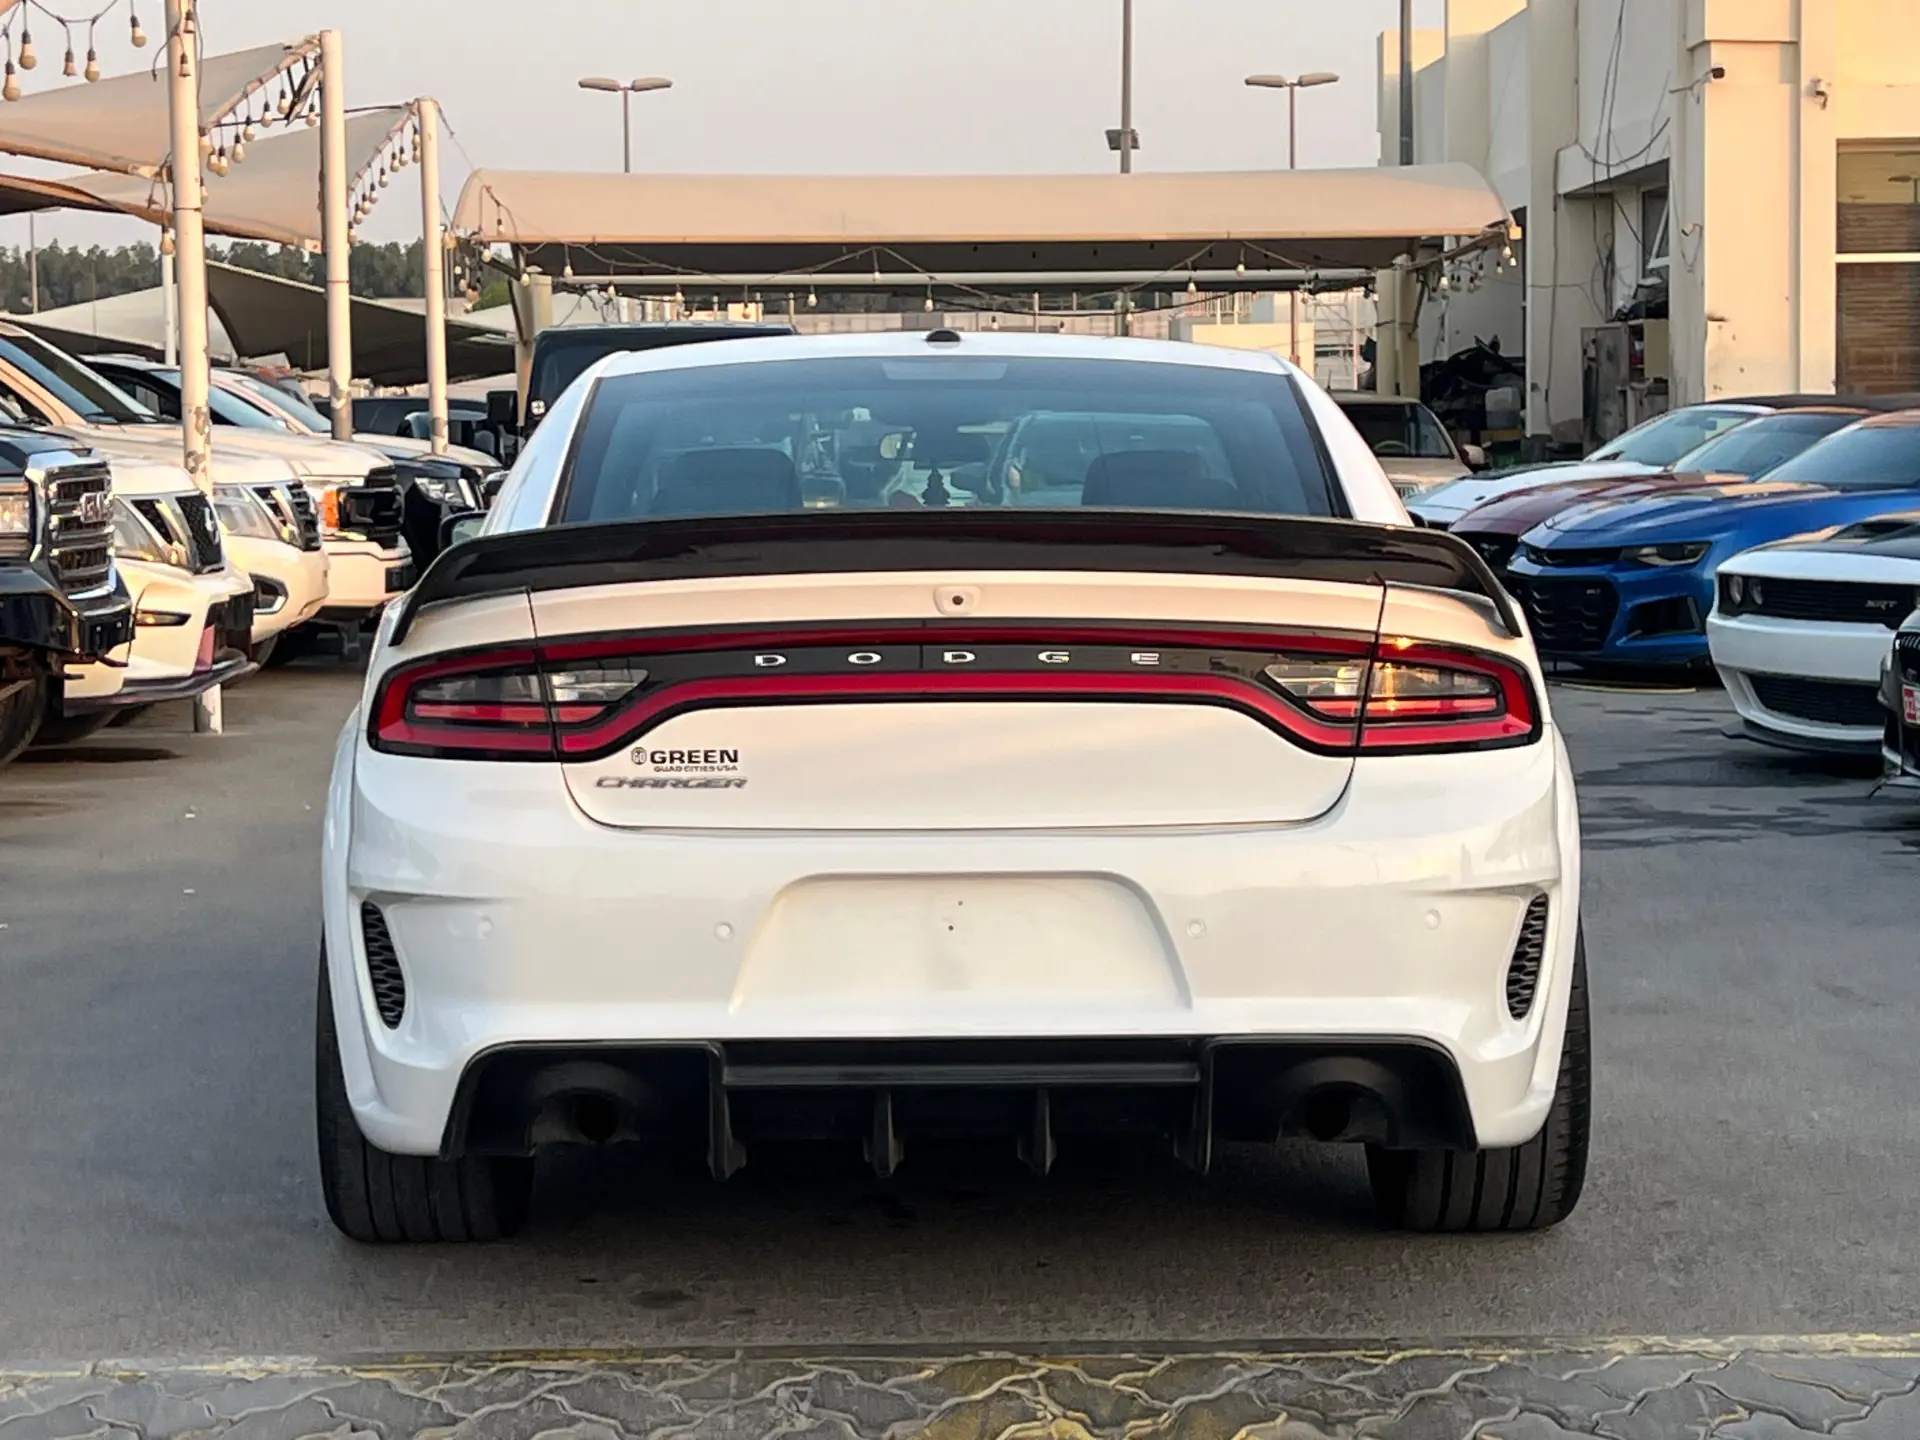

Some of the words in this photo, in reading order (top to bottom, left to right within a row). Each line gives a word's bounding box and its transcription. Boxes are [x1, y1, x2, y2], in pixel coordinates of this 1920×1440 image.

[754, 650, 1160, 667] DODGE
[650, 749, 739, 764] GREEN
[595, 776, 748, 789] CHARGER
